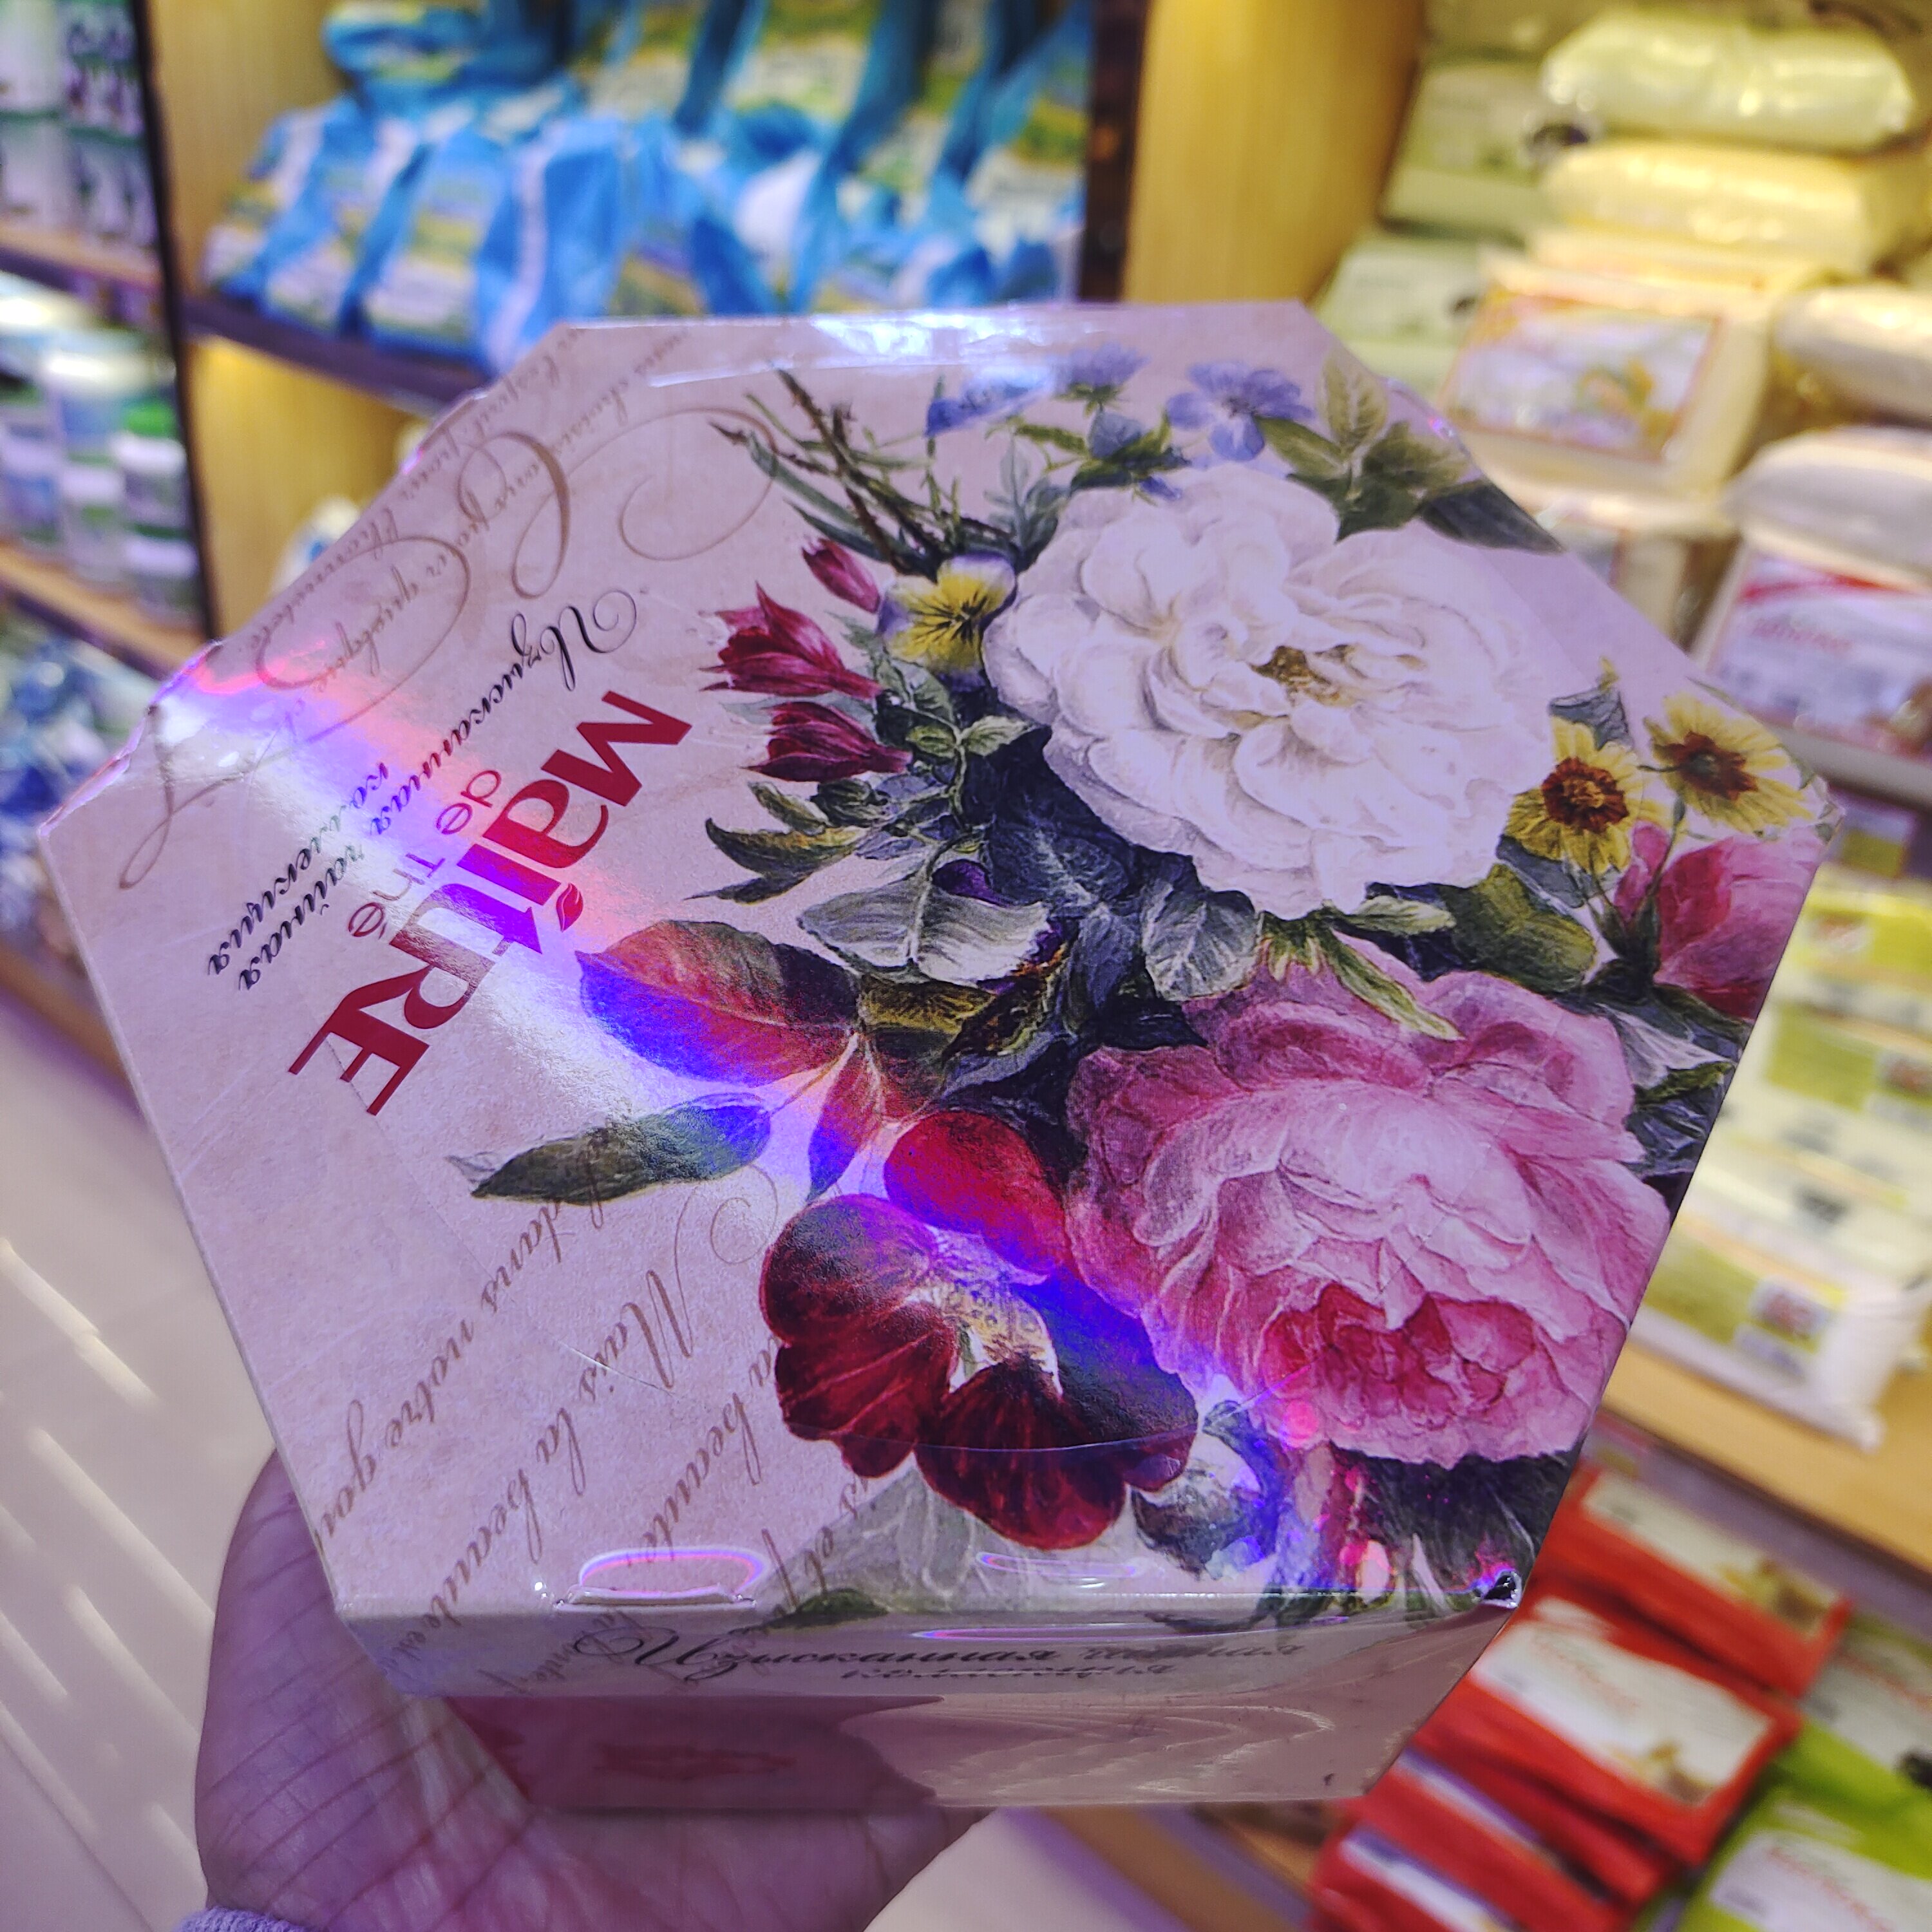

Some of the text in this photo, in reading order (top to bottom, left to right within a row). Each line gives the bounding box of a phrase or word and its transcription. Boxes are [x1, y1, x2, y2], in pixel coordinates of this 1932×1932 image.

[238, 589, 638, 990] Изысканная чайная
[435, 768, 502, 837] de
[207, 762, 389, 976] коллекция
[480, 1200, 567, 1313] dans
[578, 1164, 778, 1401] Mais
[386, 1318, 474, 1448] notre
[535, 1408, 586, 1496] la
